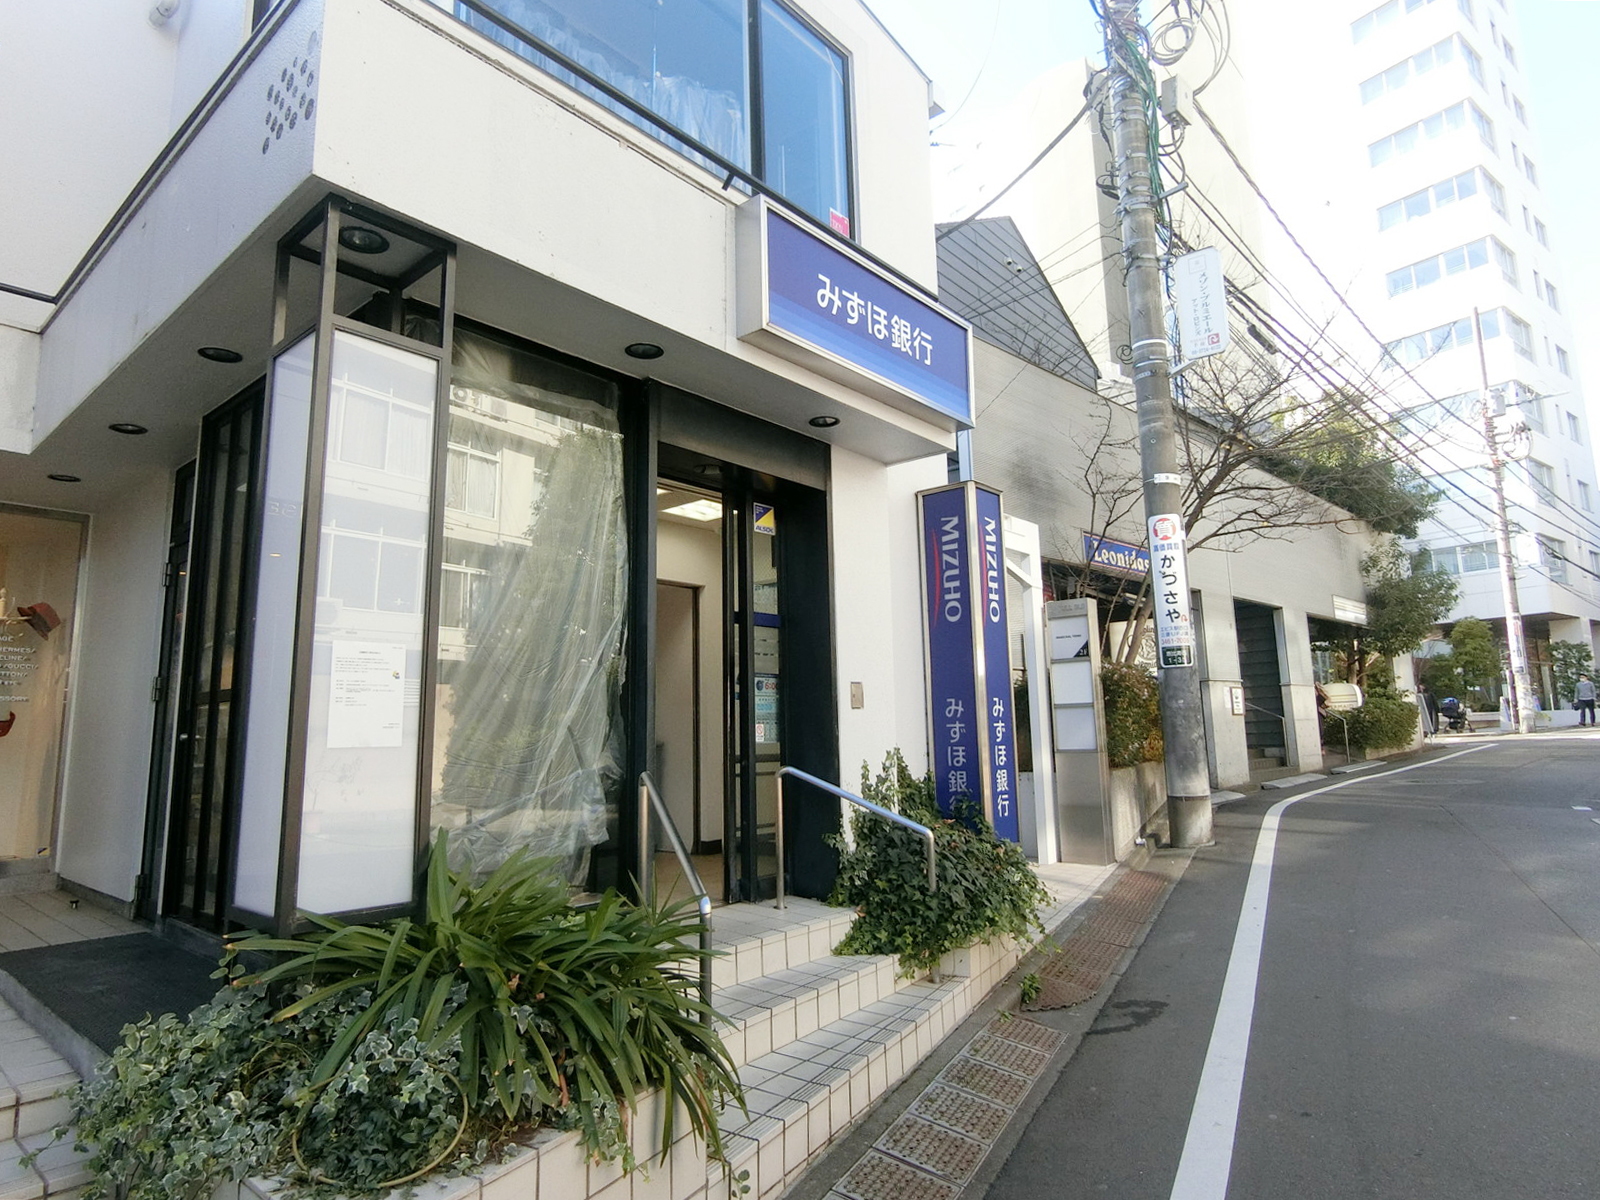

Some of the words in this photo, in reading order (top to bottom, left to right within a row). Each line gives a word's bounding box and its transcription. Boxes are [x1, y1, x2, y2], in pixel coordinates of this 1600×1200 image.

[816, 273, 933, 366] みずほ銀行
[940, 515, 962, 623] MIZUHO
[984, 516, 1000, 623] MIZUHO
[992, 697, 1010, 818] みずほ銀行
